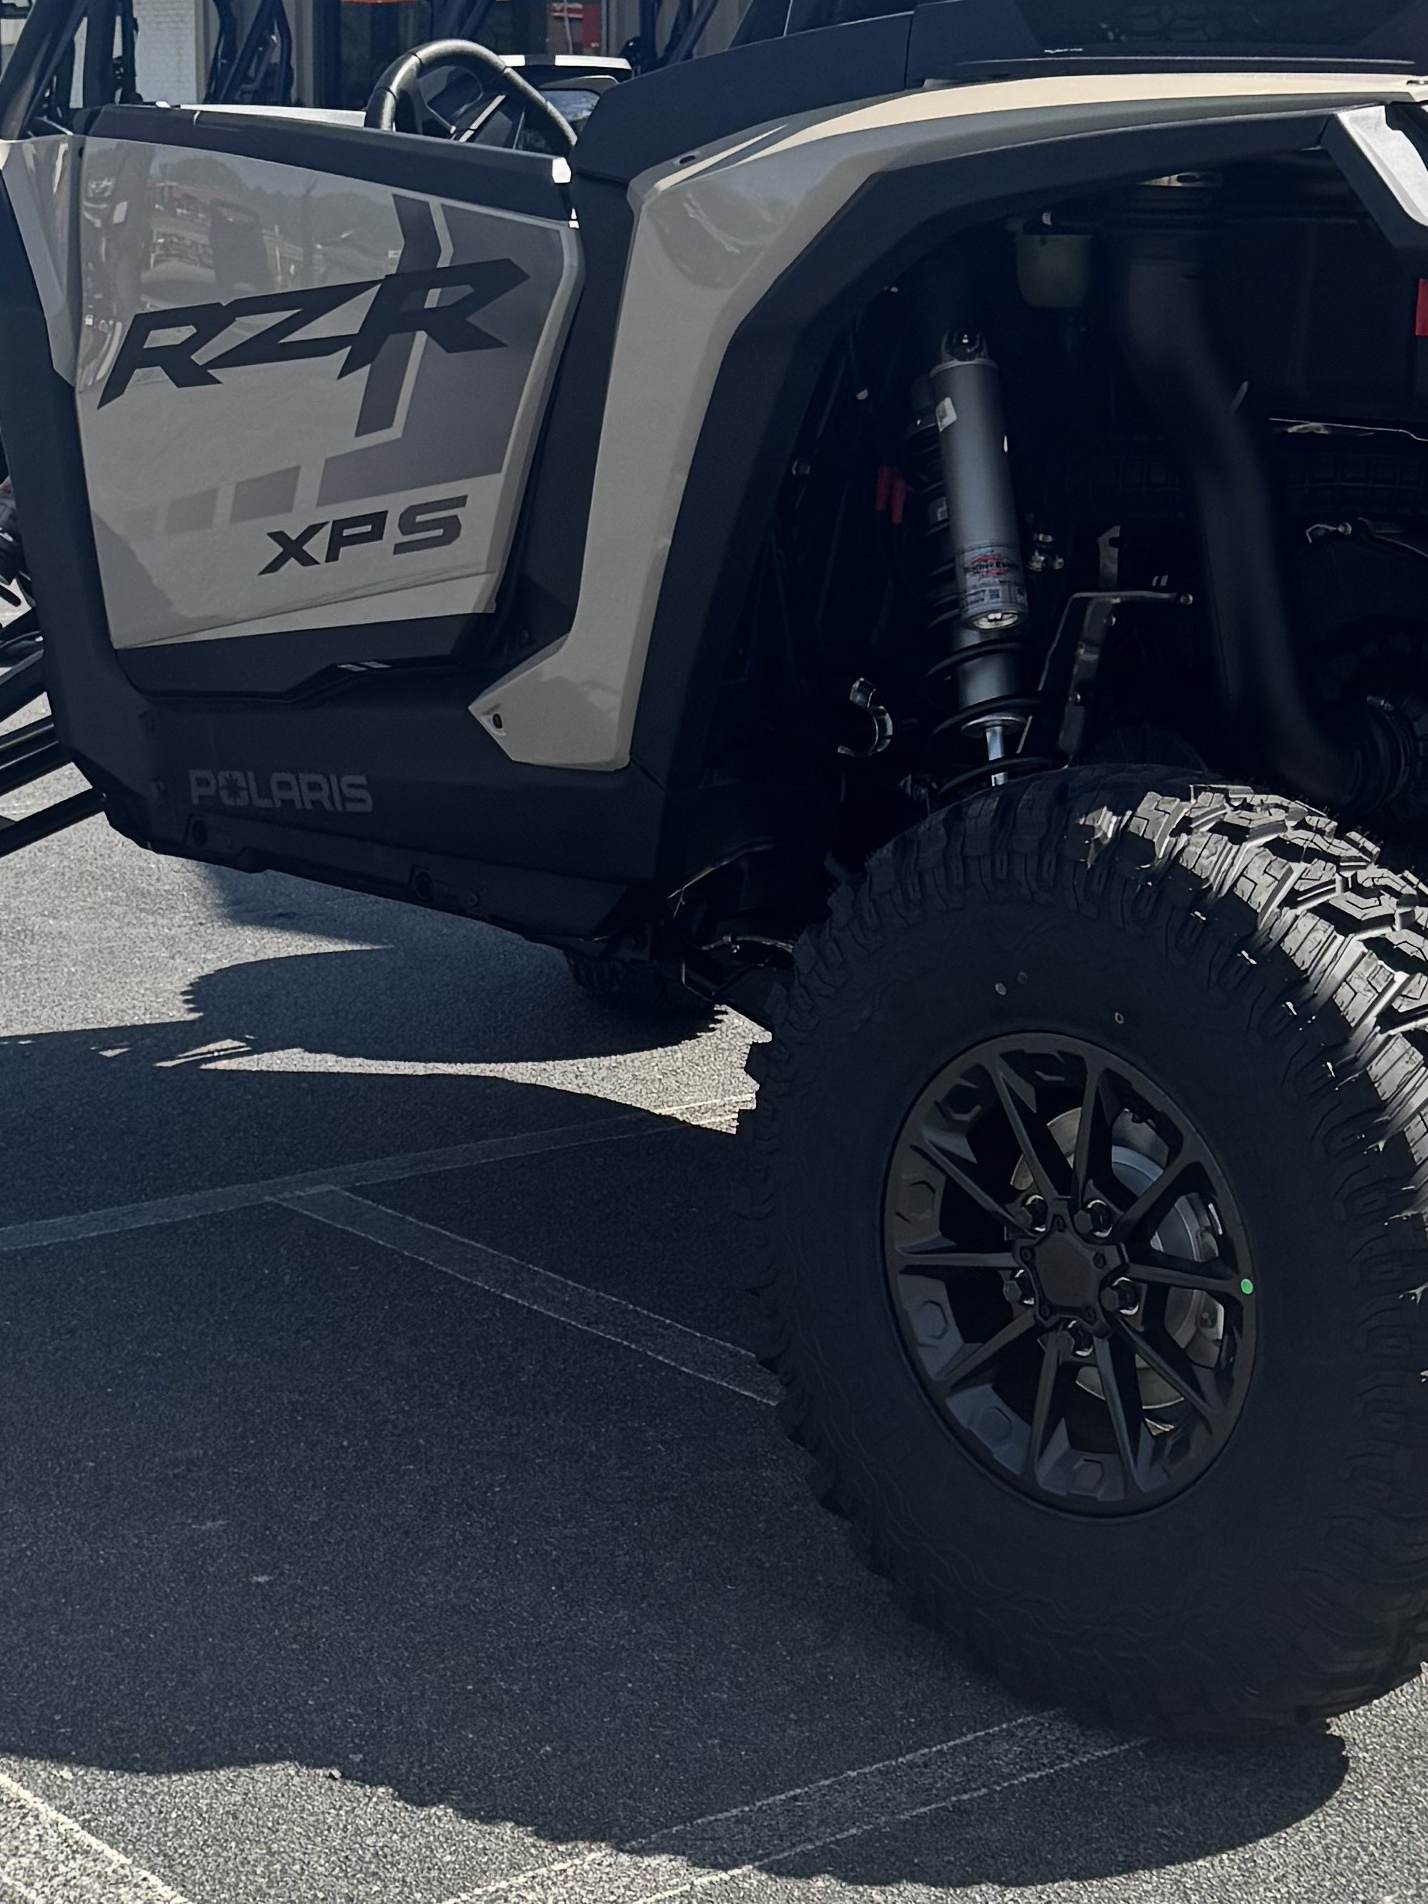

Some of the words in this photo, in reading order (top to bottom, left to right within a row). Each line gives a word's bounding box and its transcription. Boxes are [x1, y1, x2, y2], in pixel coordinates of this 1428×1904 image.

[97, 258, 530, 410] RZR
[258, 495, 468, 576] XPS
[188, 769, 373, 813] POLARIS
